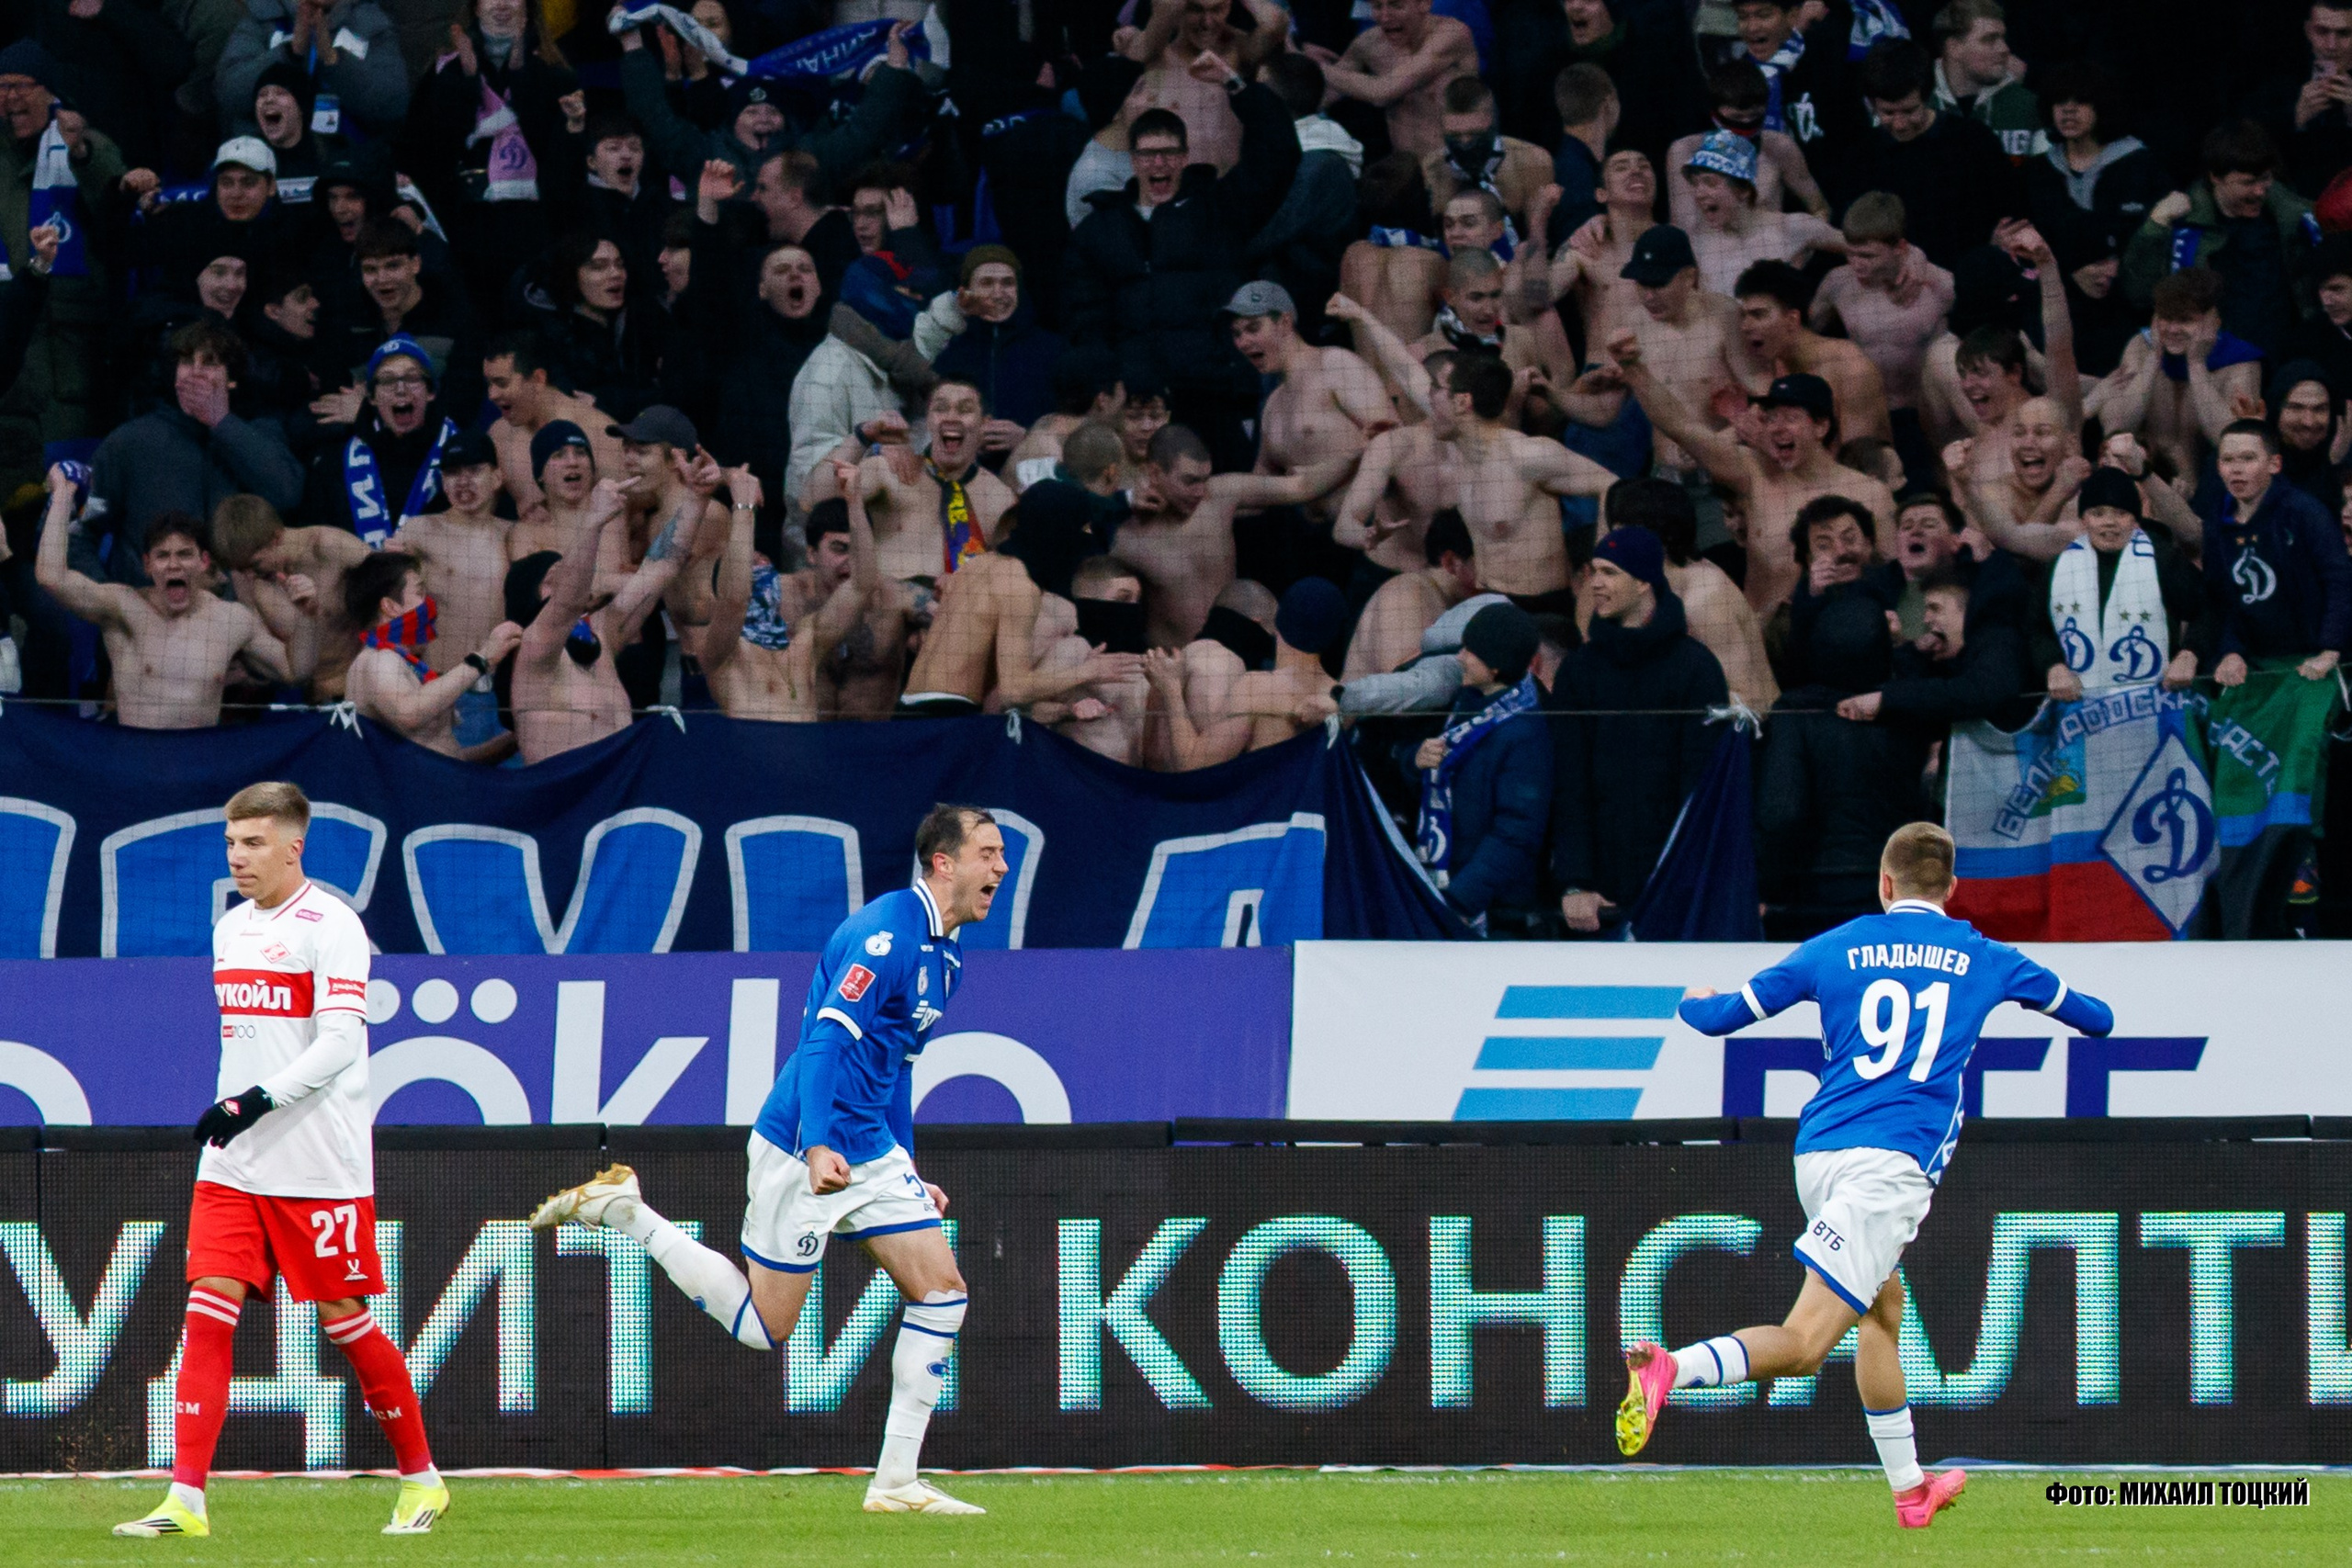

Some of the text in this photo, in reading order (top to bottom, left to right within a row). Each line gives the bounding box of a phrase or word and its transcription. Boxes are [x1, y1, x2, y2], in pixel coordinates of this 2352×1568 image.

[1847, 943, 1971, 976] ГЛАДЫШЕВ
[1852, 978, 1951, 1083] 91
[311, 1203, 357, 1258] 27
[1813, 1220, 1845, 1251] ВТБ
